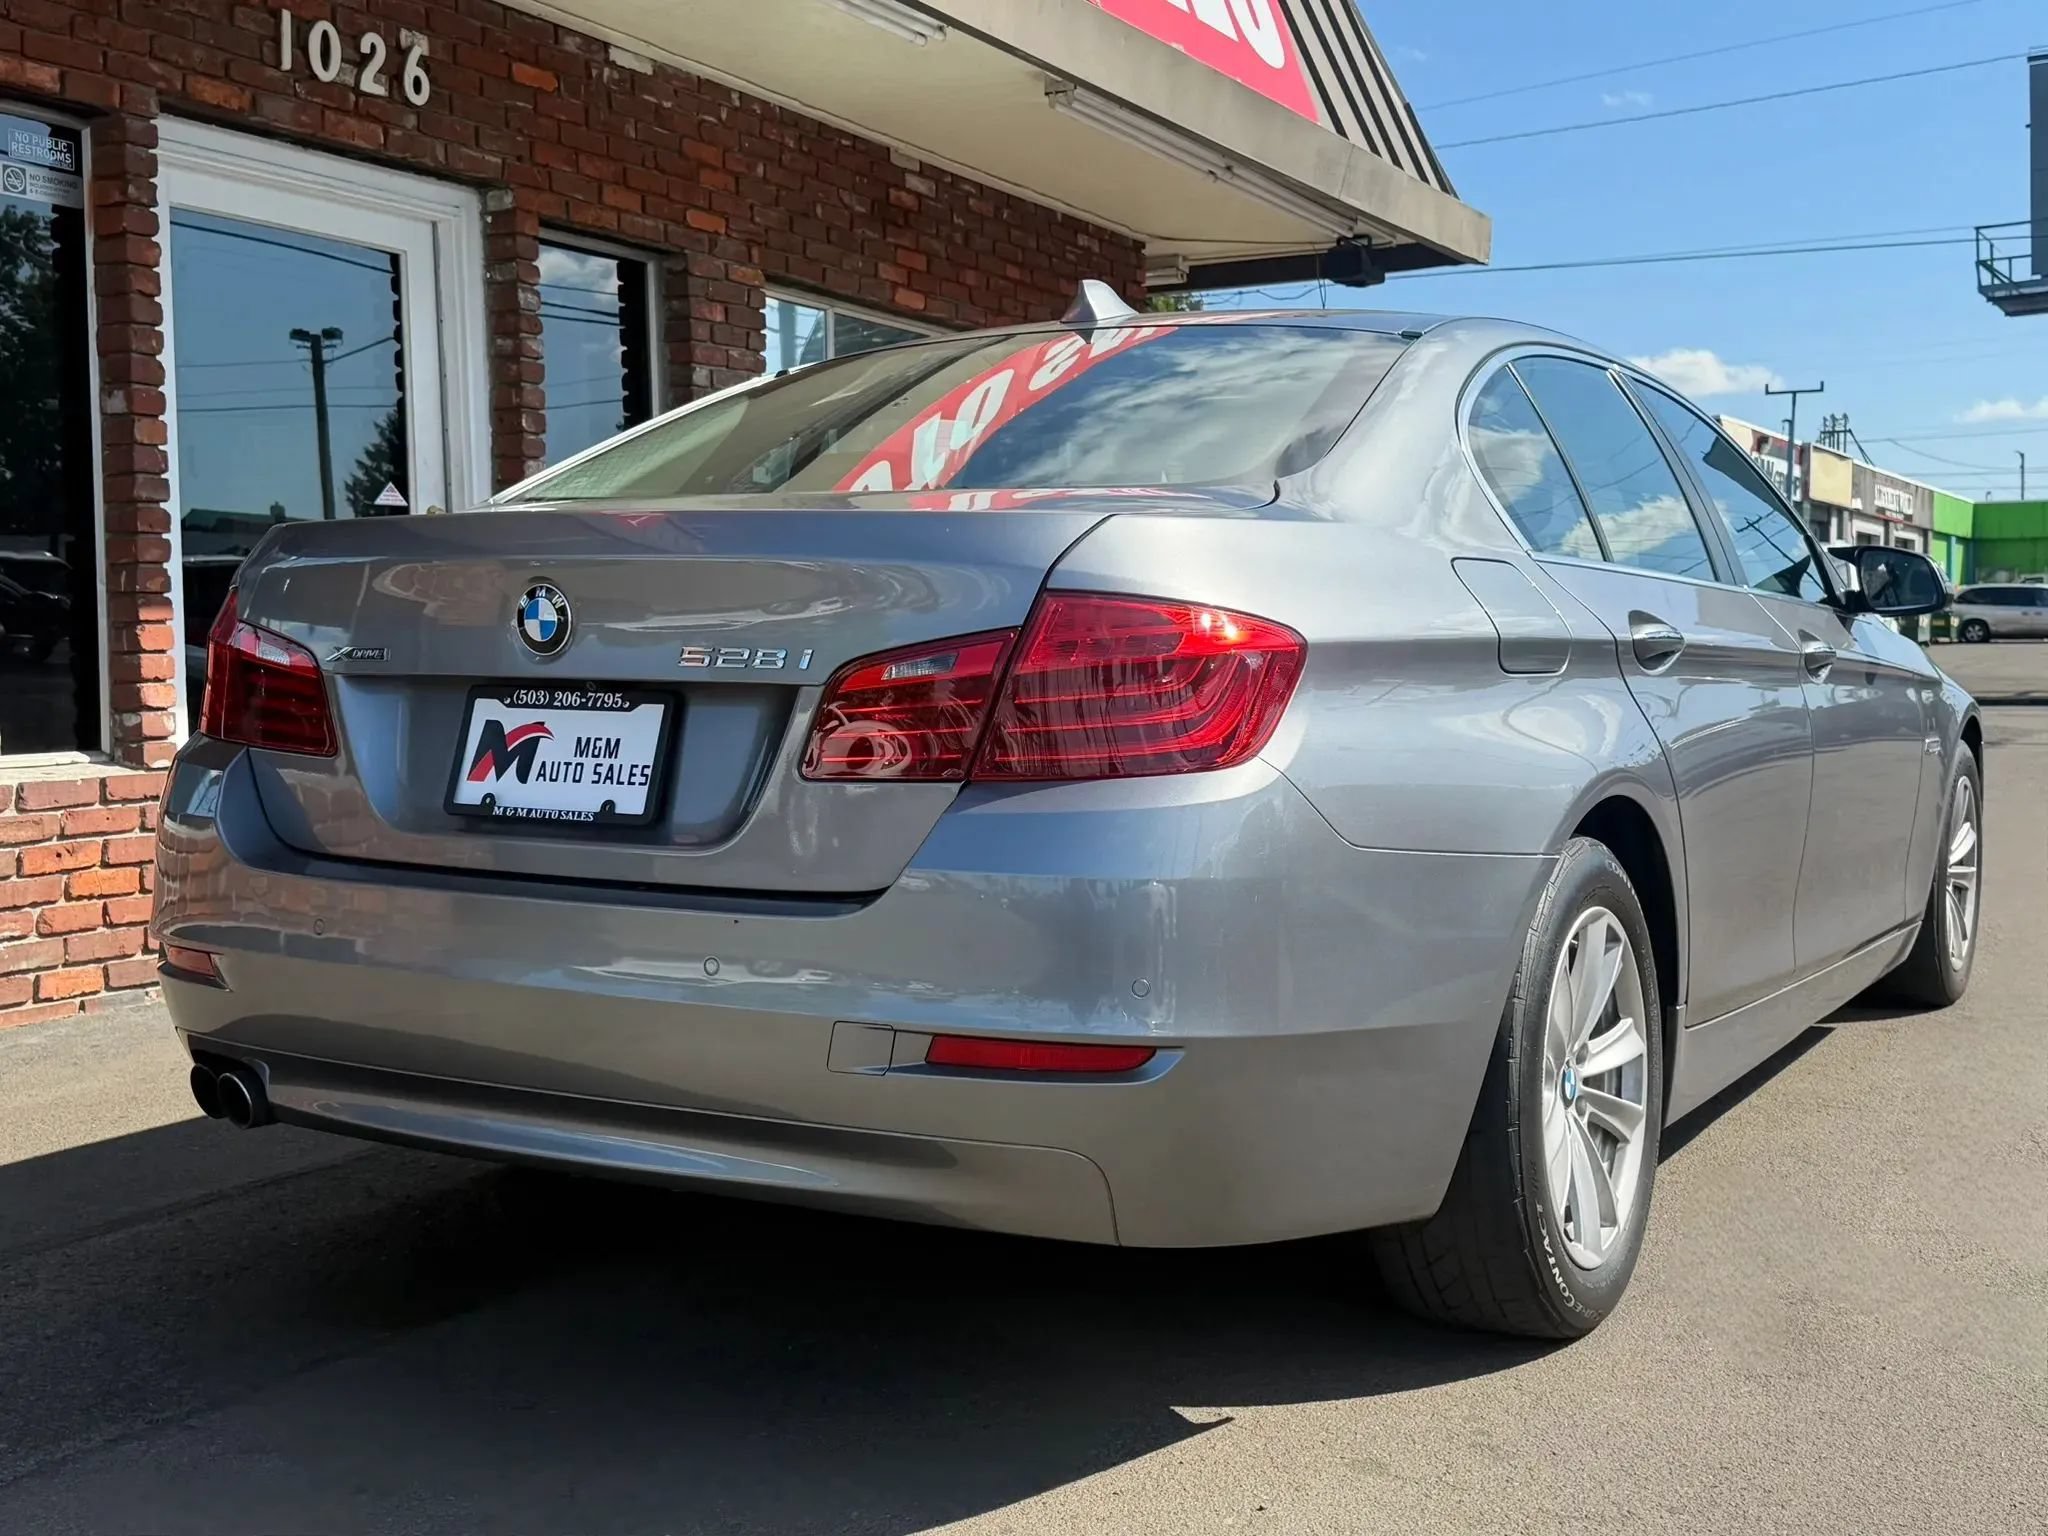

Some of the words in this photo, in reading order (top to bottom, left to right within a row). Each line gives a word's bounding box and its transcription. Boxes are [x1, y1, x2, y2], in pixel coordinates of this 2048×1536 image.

[280, 8, 430, 106] 1026
[11, 141, 72, 163] RESTROOMS
[15, 132, 29, 143] NO
[32, 136, 68, 152] PUBLIC
[29, 173, 40, 181] NO
[41, 175, 78, 190] SMOKING
[520, 586, 565, 610] BMW
[513, 689, 549, 706] (503)
[553, 691, 622, 708] 206-7795
[535, 760, 584, 784] AUTO
[591, 763, 651, 787] SALES
[492, 806, 505, 816] M
[506, 807, 516, 817] &
[516, 808, 529, 818] M
[529, 809, 559, 820] AUTO
[560, 811, 594, 822] SALES
